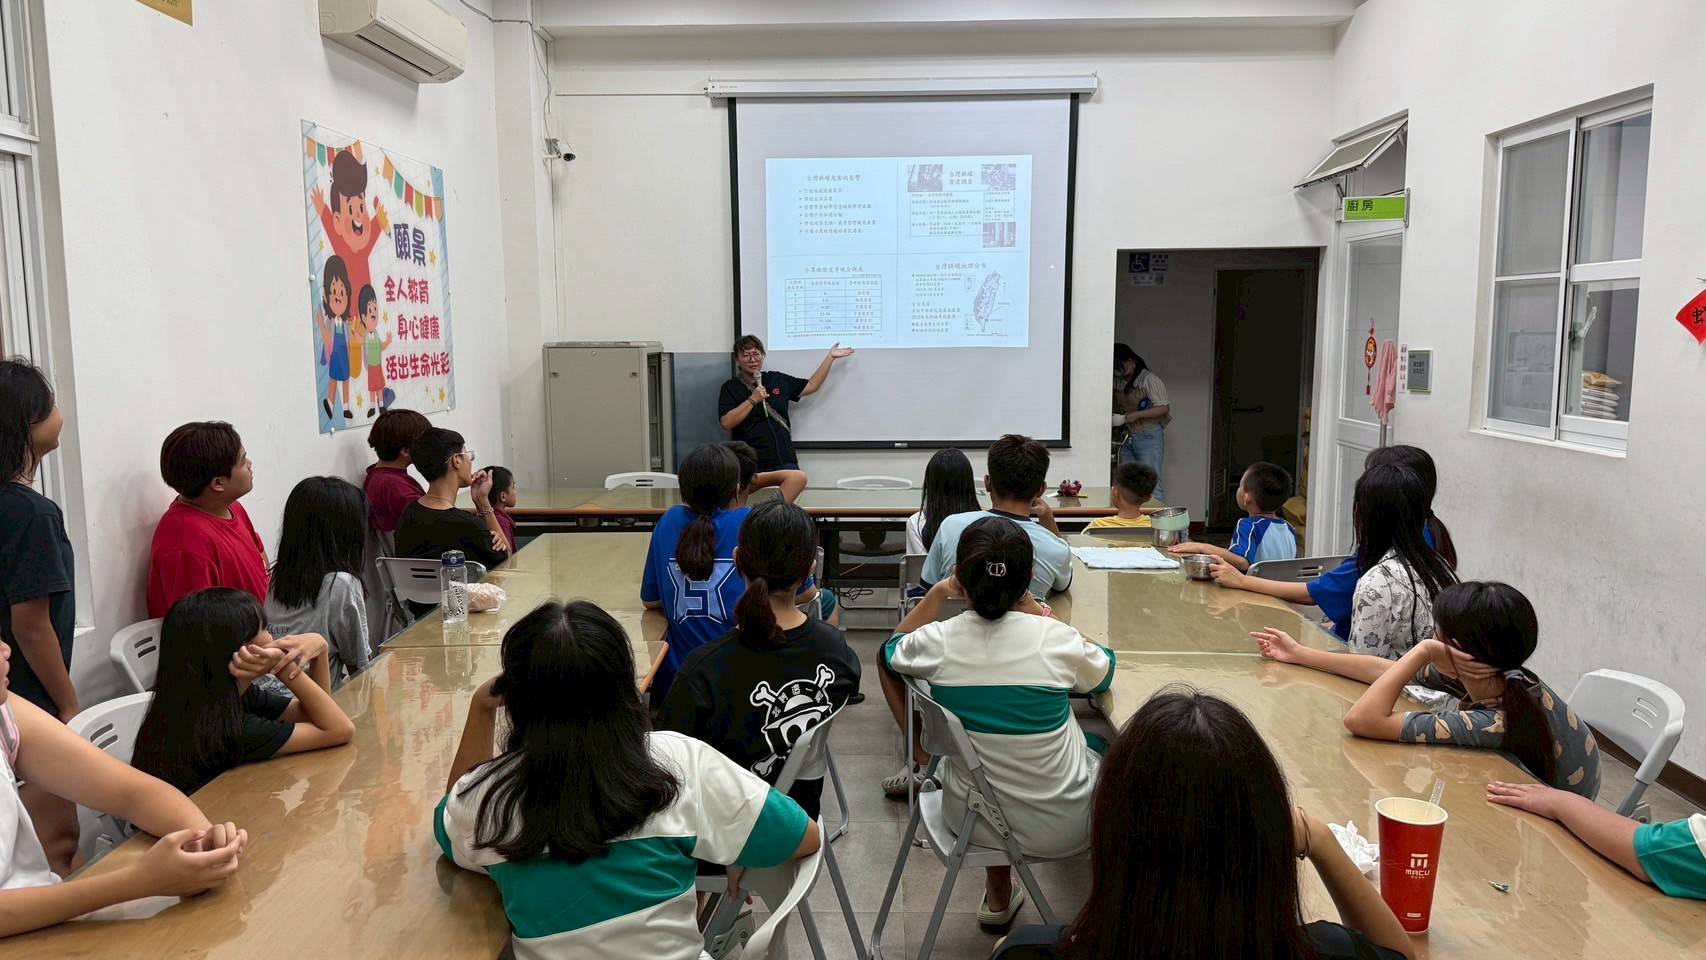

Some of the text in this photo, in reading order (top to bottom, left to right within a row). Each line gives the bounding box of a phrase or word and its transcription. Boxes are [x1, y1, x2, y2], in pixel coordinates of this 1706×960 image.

[1347, 199, 1375, 211] 廚房
[394, 223, 426, 267] 願景
[384, 275, 429, 304] 全人教育
[397, 313, 440, 341] 身心健康
[386, 351, 450, 380] 活出生命光彩
